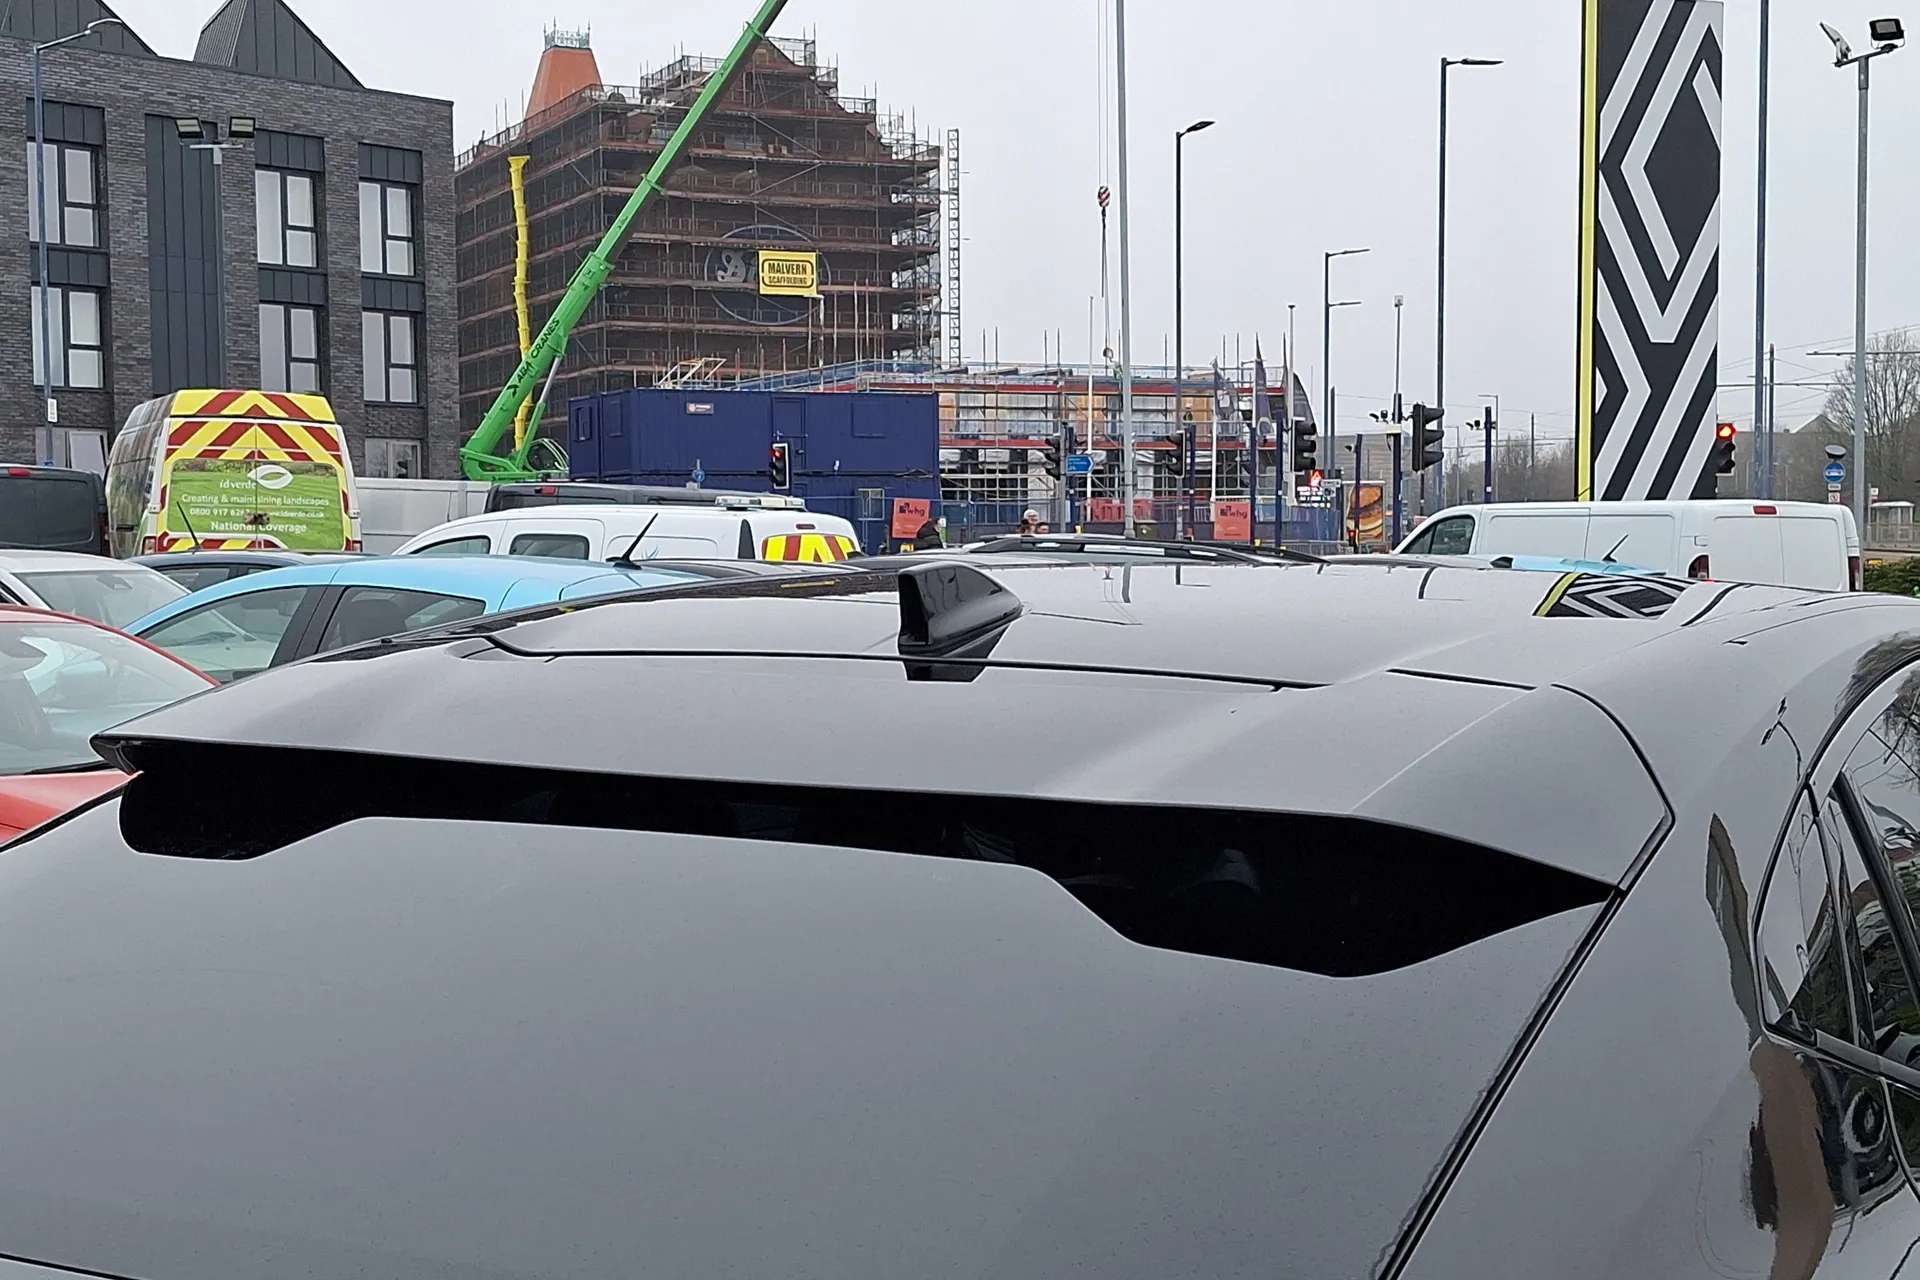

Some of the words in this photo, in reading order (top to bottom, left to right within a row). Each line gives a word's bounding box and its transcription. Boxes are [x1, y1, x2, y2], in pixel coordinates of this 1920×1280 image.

[768, 262, 807, 275] MALVERN
[768, 275, 807, 285] SCAFFOLDING
[531, 317, 560, 358] CRANES
[181, 493, 219, 505] Creating
[221, 494, 229, 504] &
[230, 495, 282, 505] maintaining
[283, 495, 329, 506] landscapes
[212, 508, 228, 516] 917
[210, 521, 256, 531] National
[259, 522, 307, 534] Coverage
